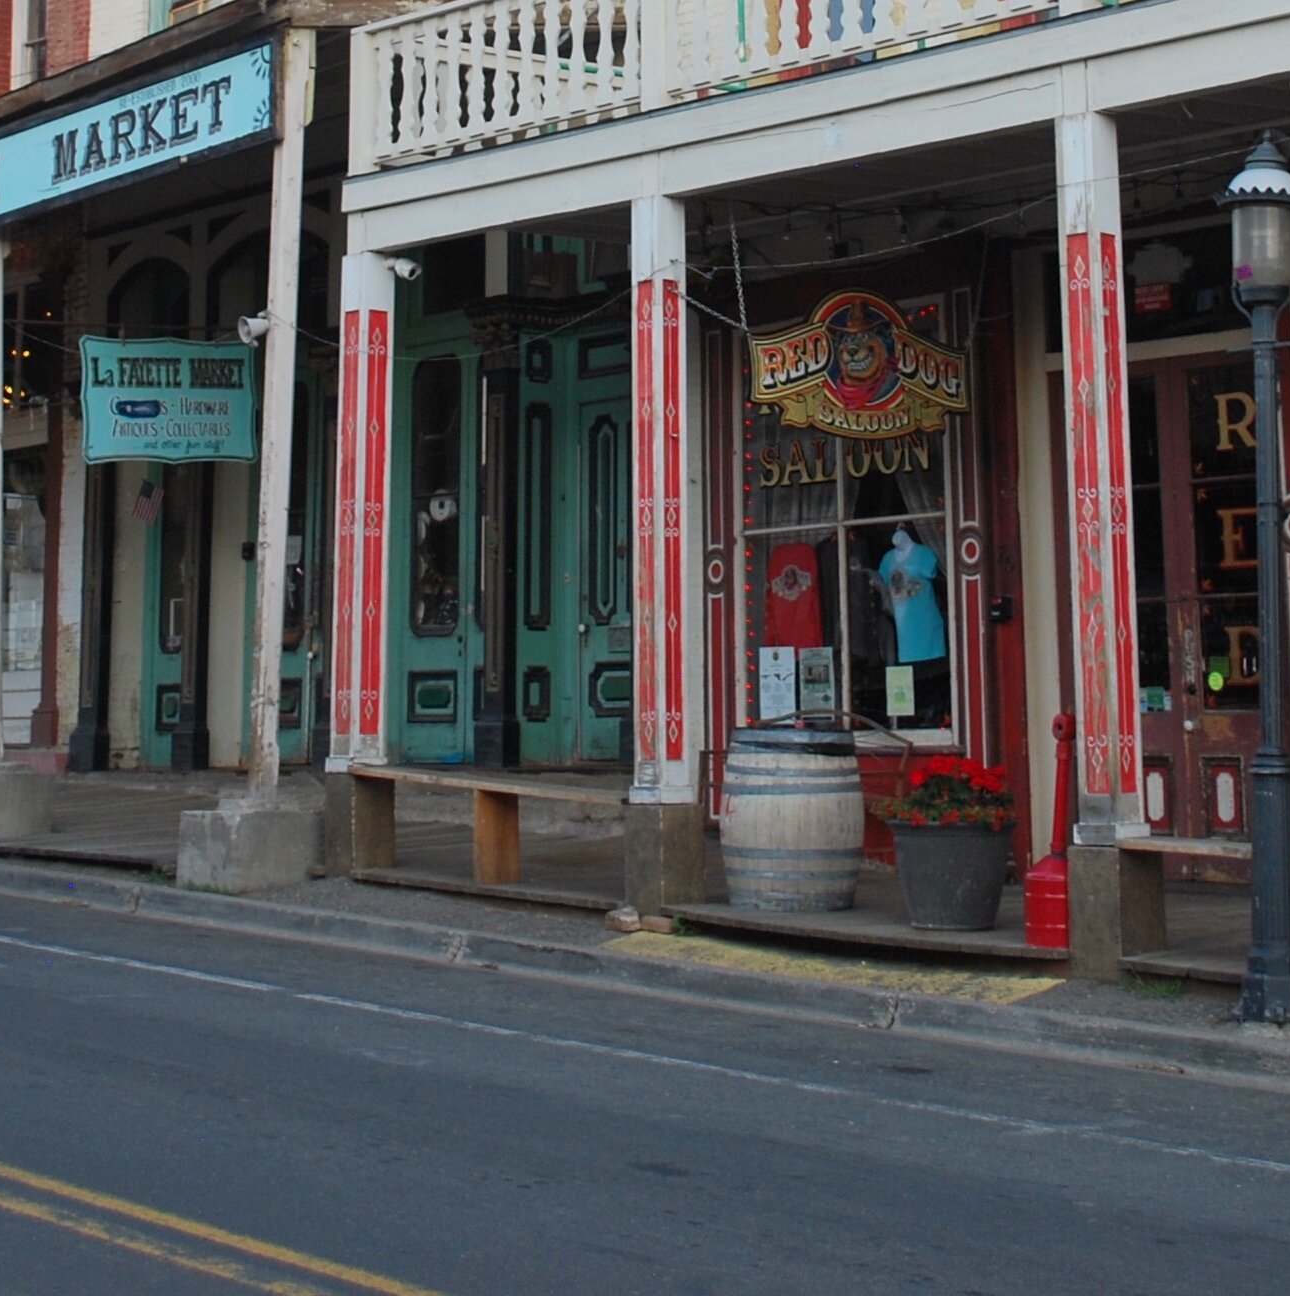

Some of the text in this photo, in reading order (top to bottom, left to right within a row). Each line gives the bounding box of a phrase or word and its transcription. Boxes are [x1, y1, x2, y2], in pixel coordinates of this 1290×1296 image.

[51, 74, 232, 185] MARKET
[91, 356, 245, 390] La FAYETTE MARKET
[761, 330, 961, 396] RED DOG
[111, 418, 158, 438] ANTIQUES
[818, 404, 910, 433] SALOON
[759, 435, 929, 489] SALOON
